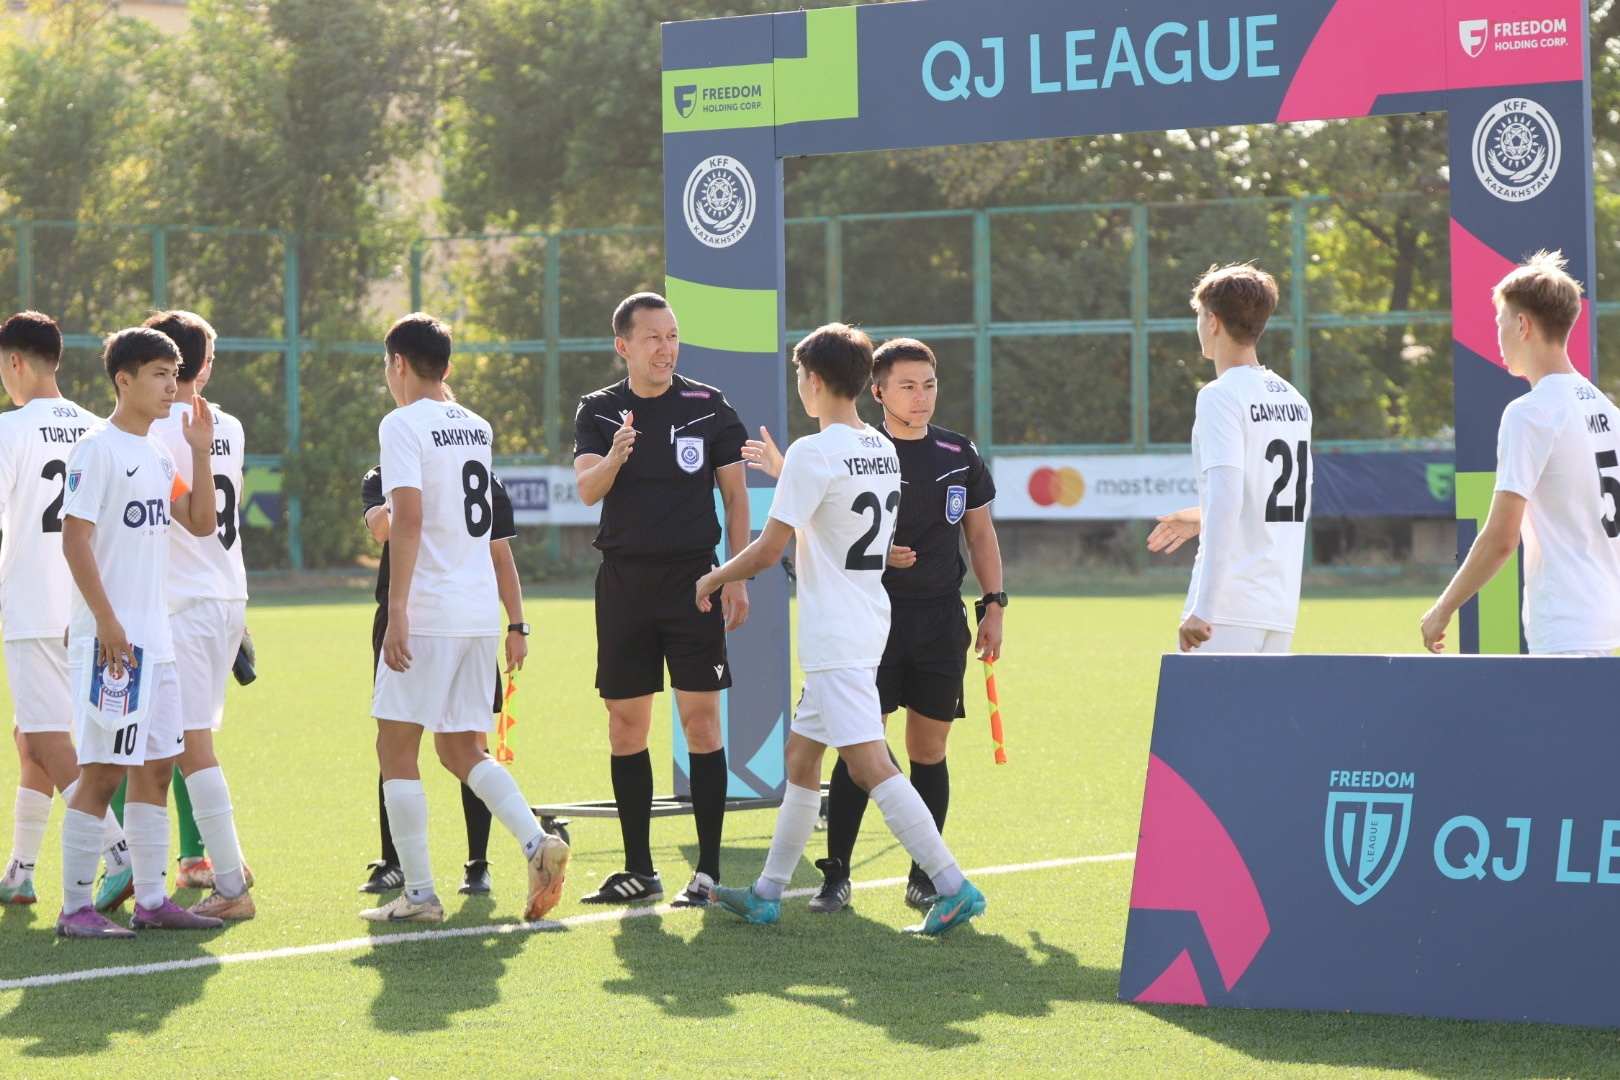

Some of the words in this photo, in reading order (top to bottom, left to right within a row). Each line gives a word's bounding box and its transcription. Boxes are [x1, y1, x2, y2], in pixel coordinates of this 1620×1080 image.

[1494, 18, 1567, 37] FREEDOM
[1495, 39, 1538, 51] HOLDING
[1540, 37, 1568, 48] CORP.
[922, 37, 1005, 101] QJ
[1029, 14, 1280, 94] LEAGUE
[702, 85, 762, 101] FREEDOM
[702, 103, 738, 113] HOLDING
[740, 101, 763, 110] CORP.
[1504, 100, 1527, 113] KFF
[709, 157, 729, 168] KFF
[1484, 172, 1550, 198] KAZAKHSTAN
[693, 222, 747, 245] KAZAKHSTAN
[843, 456, 901, 476] YERMEKU
[1265, 438, 1308, 523] 21
[462, 460, 492, 538] 8
[1595, 450, 1620, 539] 5
[113, 723, 138, 756] 10
[1329, 770, 1415, 789] FREEDOM
[1366, 819, 1379, 863] LEAGUE
[1433, 815, 1532, 882] QJ
